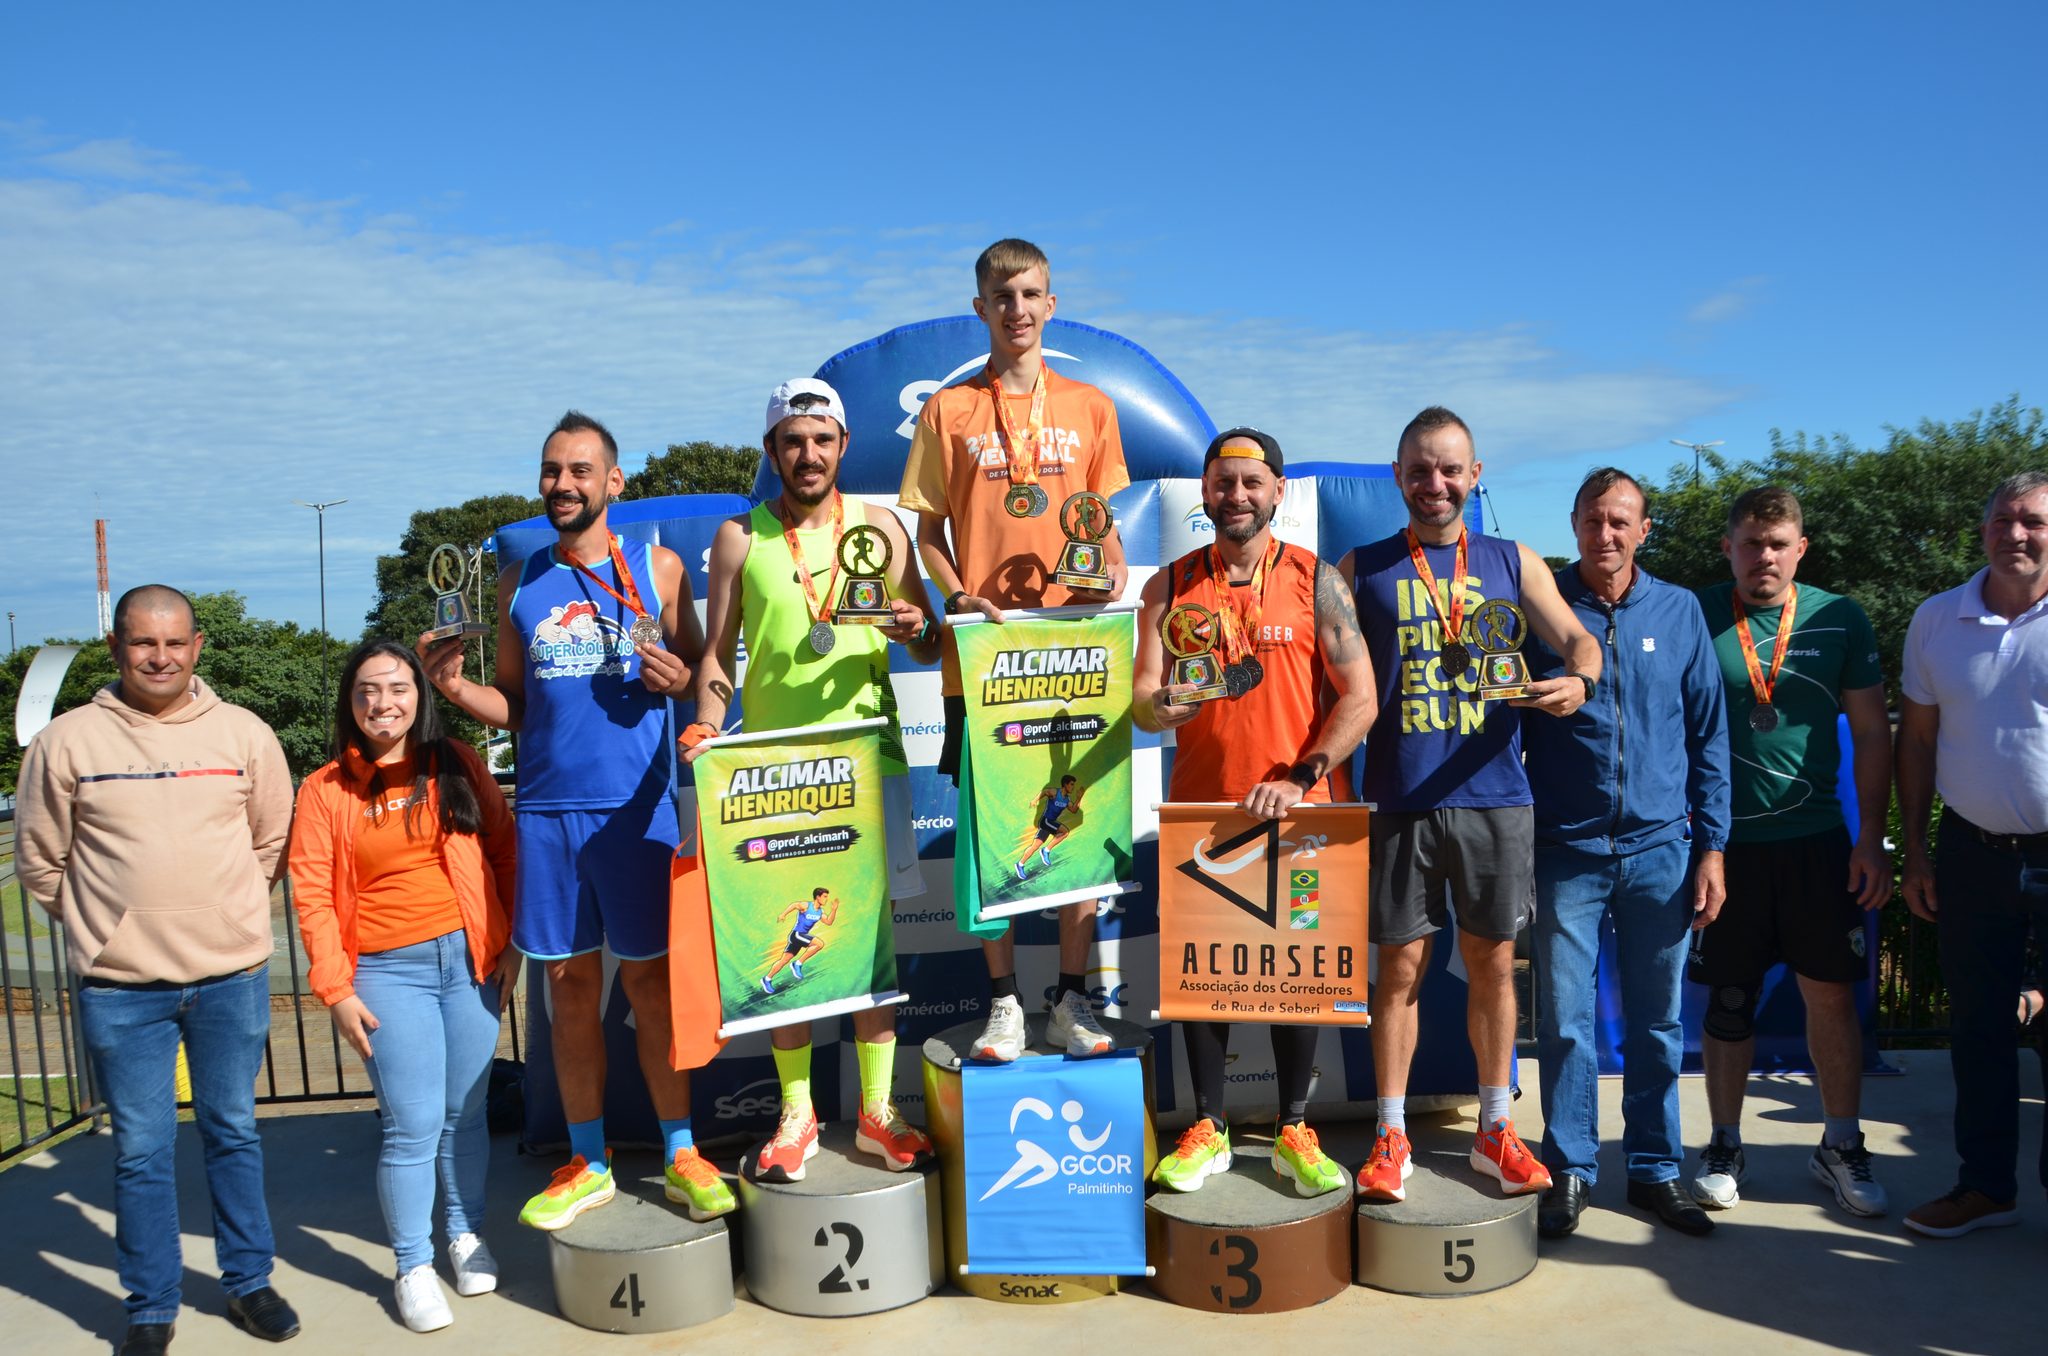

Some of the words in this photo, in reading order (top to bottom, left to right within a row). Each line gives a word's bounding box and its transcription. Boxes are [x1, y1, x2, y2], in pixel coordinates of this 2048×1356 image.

[1281, 516, 1300, 528] RS
[1396, 576, 1486, 621] INS
[529, 643, 575, 662] SUPER
[992, 648, 1106, 678] ALCIMAR
[1402, 656, 1482, 695] ECO
[984, 672, 1105, 703] HENRIQUE
[1402, 696, 1486, 735] RUN
[1023, 719, 1098, 736] @prof_alcimarh
[128, 759, 201, 772] PARIS
[730, 757, 852, 796] ALCIMAR
[723, 783, 852, 822] HENRIQUE
[767, 830, 849, 851] @prof_alcimarh
[893, 909, 955, 923] omércio
[1182, 943, 1353, 978] ACORSEB
[1179, 980, 1249, 995] Associação
[1253, 981, 1276, 993] dos
[1280, 982, 1353, 996] Corredores
[960, 998, 979, 1012] RS
[1211, 1000, 1227, 1012] de
[1231, 1001, 1255, 1012] Rua
[1259, 1001, 1275, 1013] de
[1280, 1002, 1320, 1014] Seberi
[714, 1096, 782, 1118] Ses
[1060, 1154, 1132, 1175] GCOR
[1068, 1183, 1133, 1194] Palmitinho
[814, 1222, 869, 1294] 2
[1444, 1238, 1475, 1284] 5
[1210, 1235, 1262, 1308] 3
[610, 1273, 645, 1317] 4
[1000, 1282, 1059, 1298] Senac
